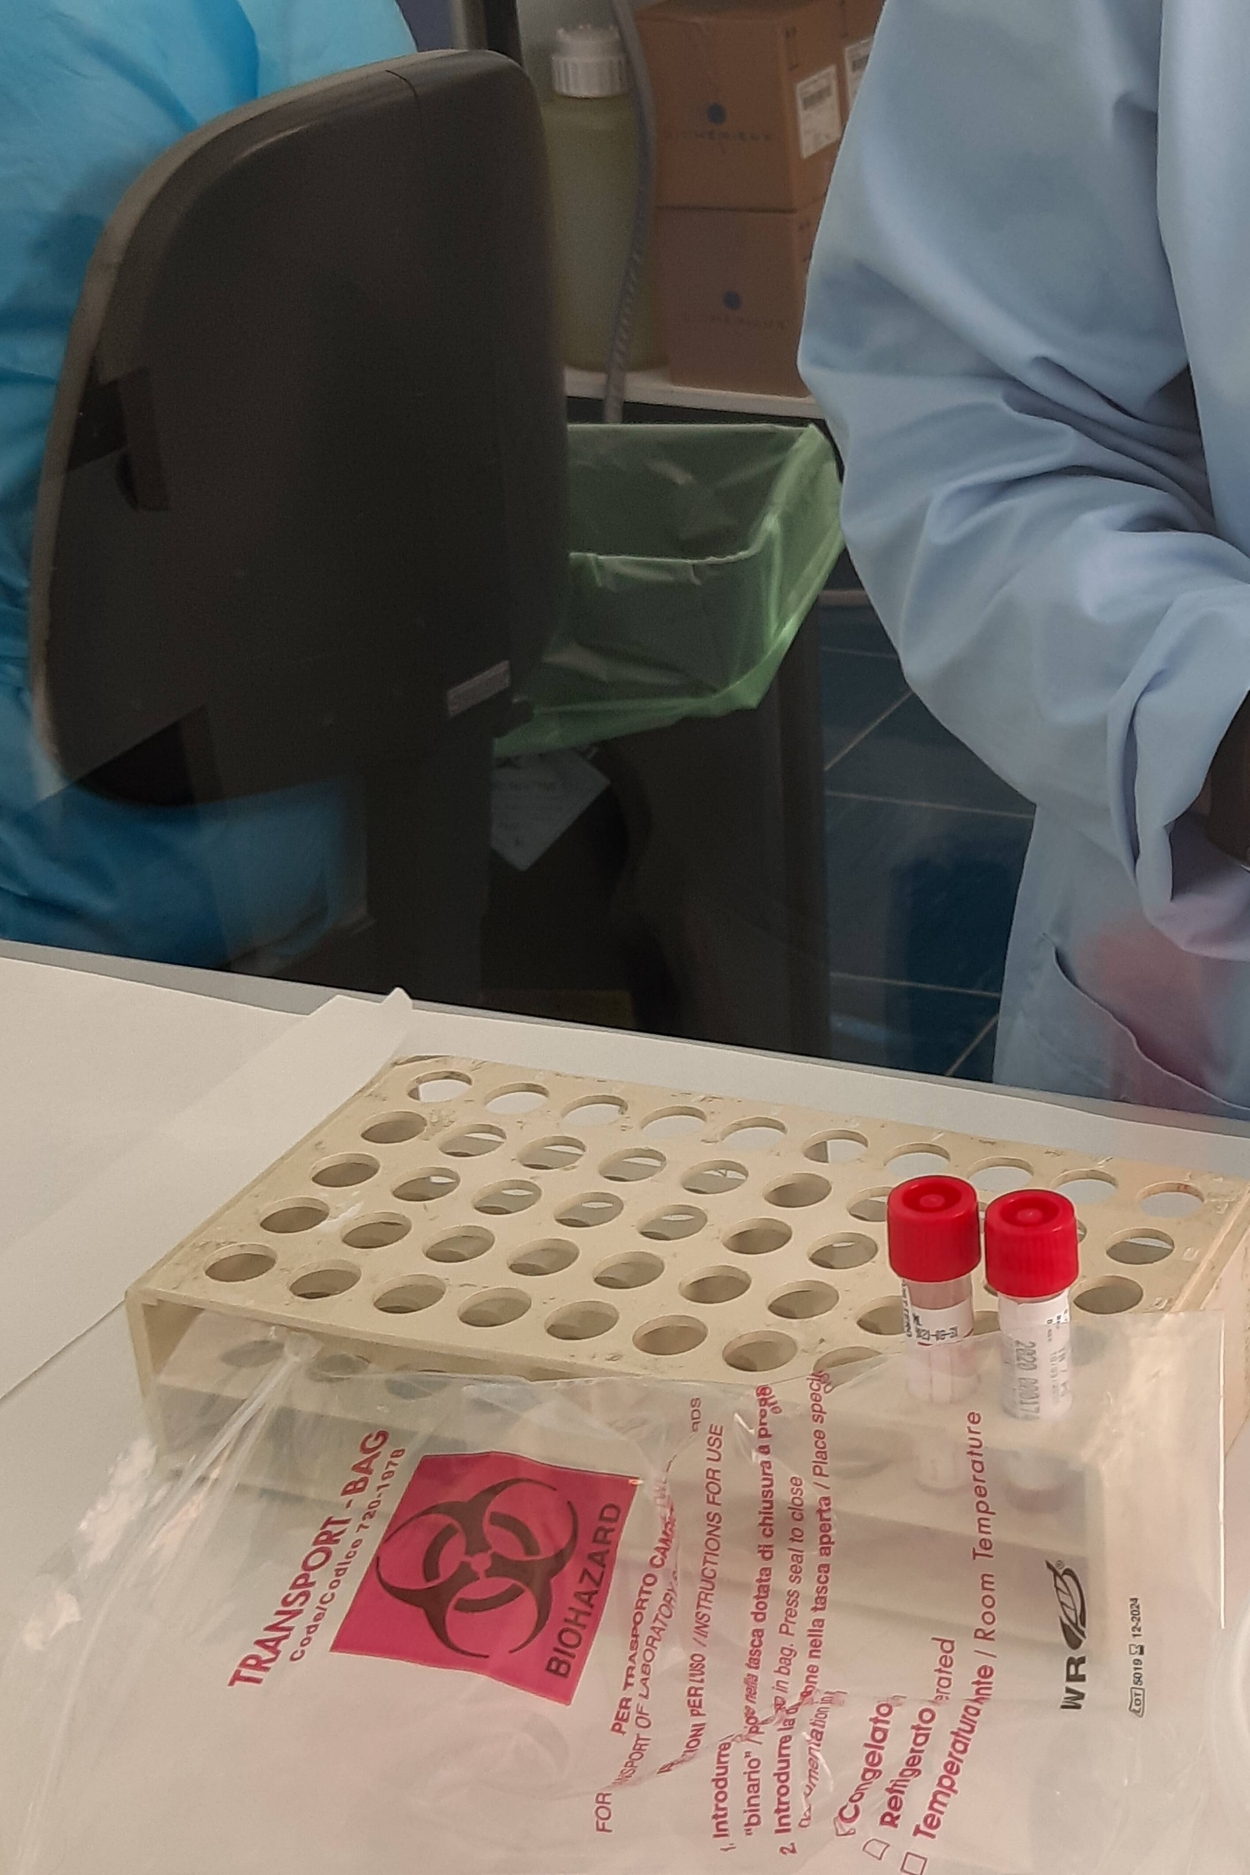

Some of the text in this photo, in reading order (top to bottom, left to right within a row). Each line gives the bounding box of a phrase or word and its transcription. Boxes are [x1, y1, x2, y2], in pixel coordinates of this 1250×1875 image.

[706, 1423, 724, 1463] USE
[757, 1444, 772, 1456] a
[812, 1428, 831, 1478] Place
[704, 1467, 723, 1507] FOR
[757, 1459, 775, 1541] chiusura
[787, 1475, 805, 1523] close
[812, 1480, 831, 1491] /
[788, 1526, 805, 1543] to
[816, 1496, 836, 1558] aperta
[227, 1515, 353, 1688] TRANSPORT
[340, 1429, 390, 1497] BAG
[757, 1543, 775, 1562] di
[787, 1547, 805, 1586] seal
[545, 1503, 622, 1680] BIOHAZARD
[750, 1566, 773, 1623] dotata
[778, 1588, 799, 1637] Press
[809, 1563, 832, 1614] tasca
[638, 1584, 678, 1700] LABORATORY
[807, 1617, 826, 1660] nella
[912, 1409, 998, 1841] Temperatura nte / Room Temperature
[610, 1697, 632, 1736] PER
[622, 1572, 659, 1691] TRASPORTO
[744, 1627, 765, 1672] tasca
[773, 1642, 798, 1677] bag.
[1129, 1596, 1145, 1717] LOT 5019 12-2024
[687, 1686, 706, 1718] PER
[771, 1677, 790, 1700] in
[634, 1702, 653, 1730] OF
[777, 1717, 796, 1733] la
[879, 1636, 958, 1831] Refrigerato erated
[772, 1733, 793, 1835] Introdurre
[837, 1702, 894, 1825] Congelato
[594, 1792, 613, 1833] FOR
[711, 1740, 732, 1839] Introdurre
